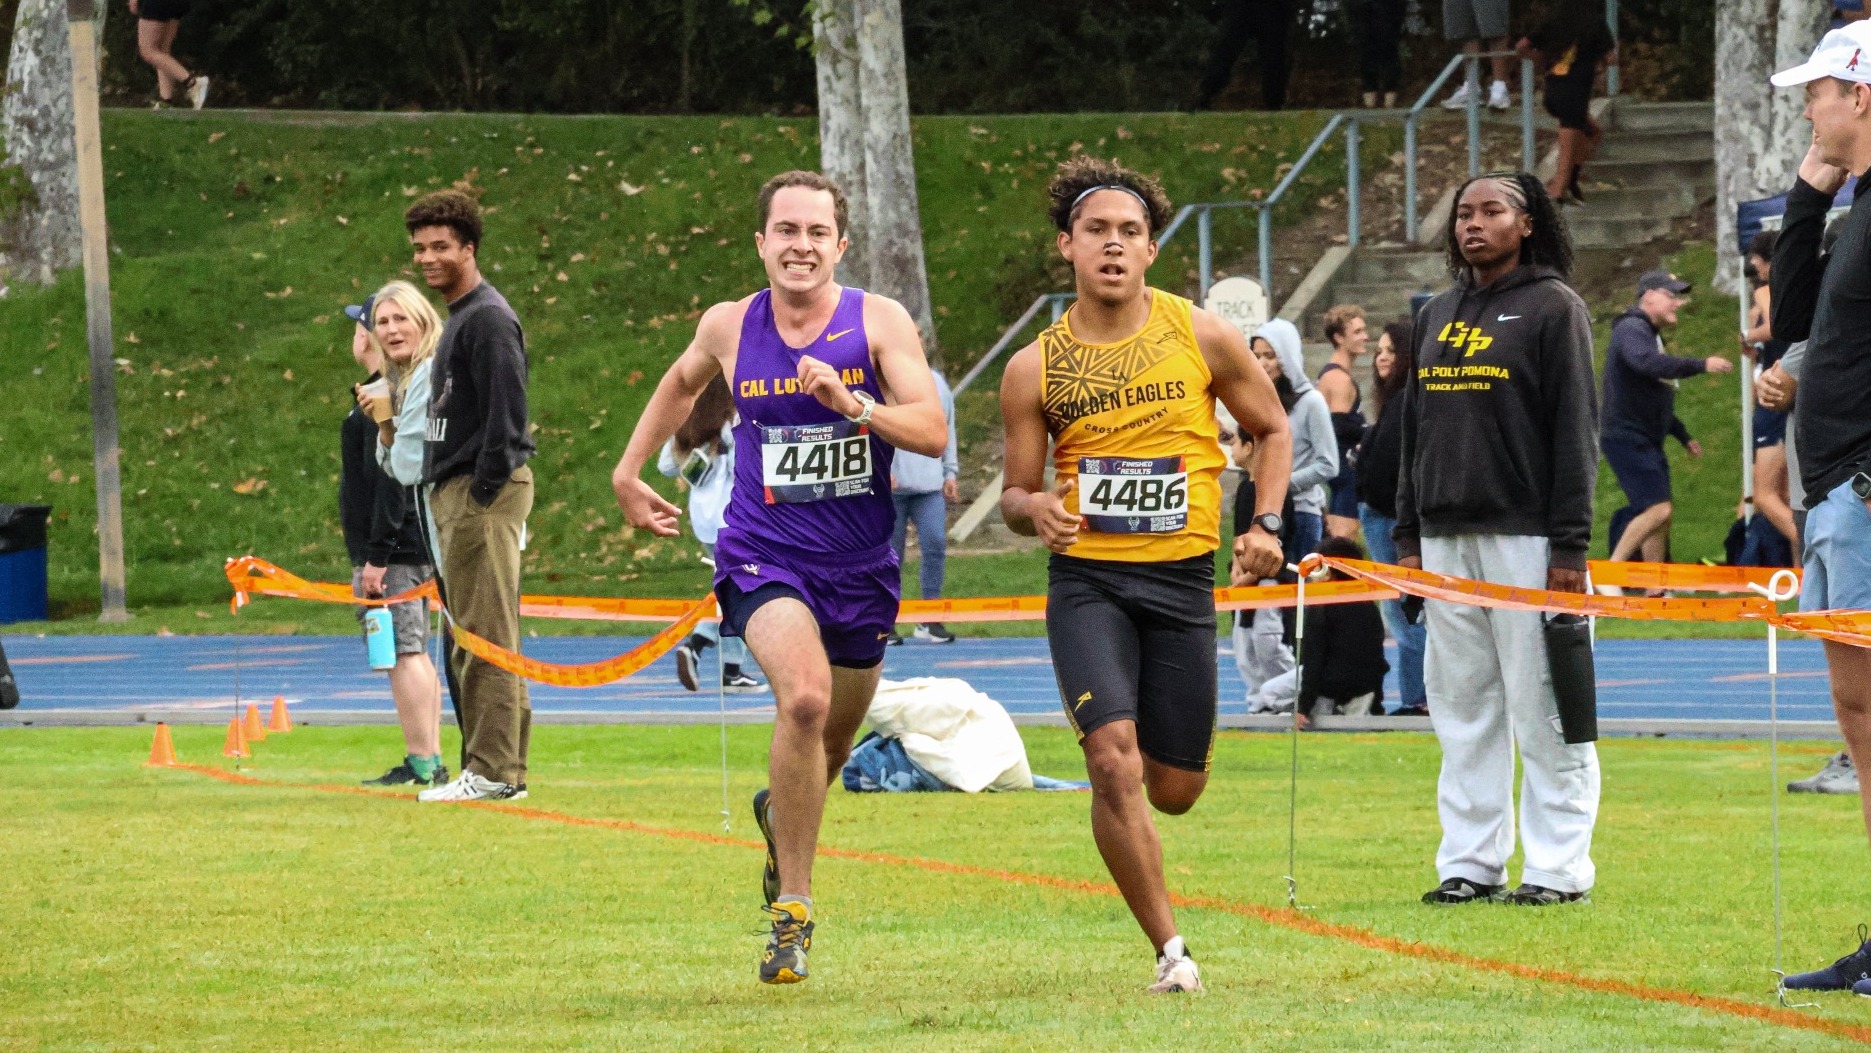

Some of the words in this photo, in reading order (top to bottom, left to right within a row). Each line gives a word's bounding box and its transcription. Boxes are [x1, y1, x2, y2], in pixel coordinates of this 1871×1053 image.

[1217, 301, 1255, 318] TRACK
[740, 379, 768, 398] CAL
[774, 368, 864, 394] LUTAN
[1432, 366, 1460, 377] POLY
[1461, 365, 1510, 379] POMONA
[1425, 383, 1452, 391] TRACK
[1452, 383, 1467, 391] AND
[1468, 382, 1491, 390] FIELD
[1061, 390, 1122, 420] GOLDEN
[1124, 380, 1186, 407] EAGLES
[802, 426, 834, 435] FINISHED
[1084, 423, 1119, 434] CROSS
[1122, 406, 1169, 431] COUNTRY
[801, 434, 832, 443] RESULTS
[775, 438, 867, 482] 4418
[1089, 476, 1186, 512] 4486
